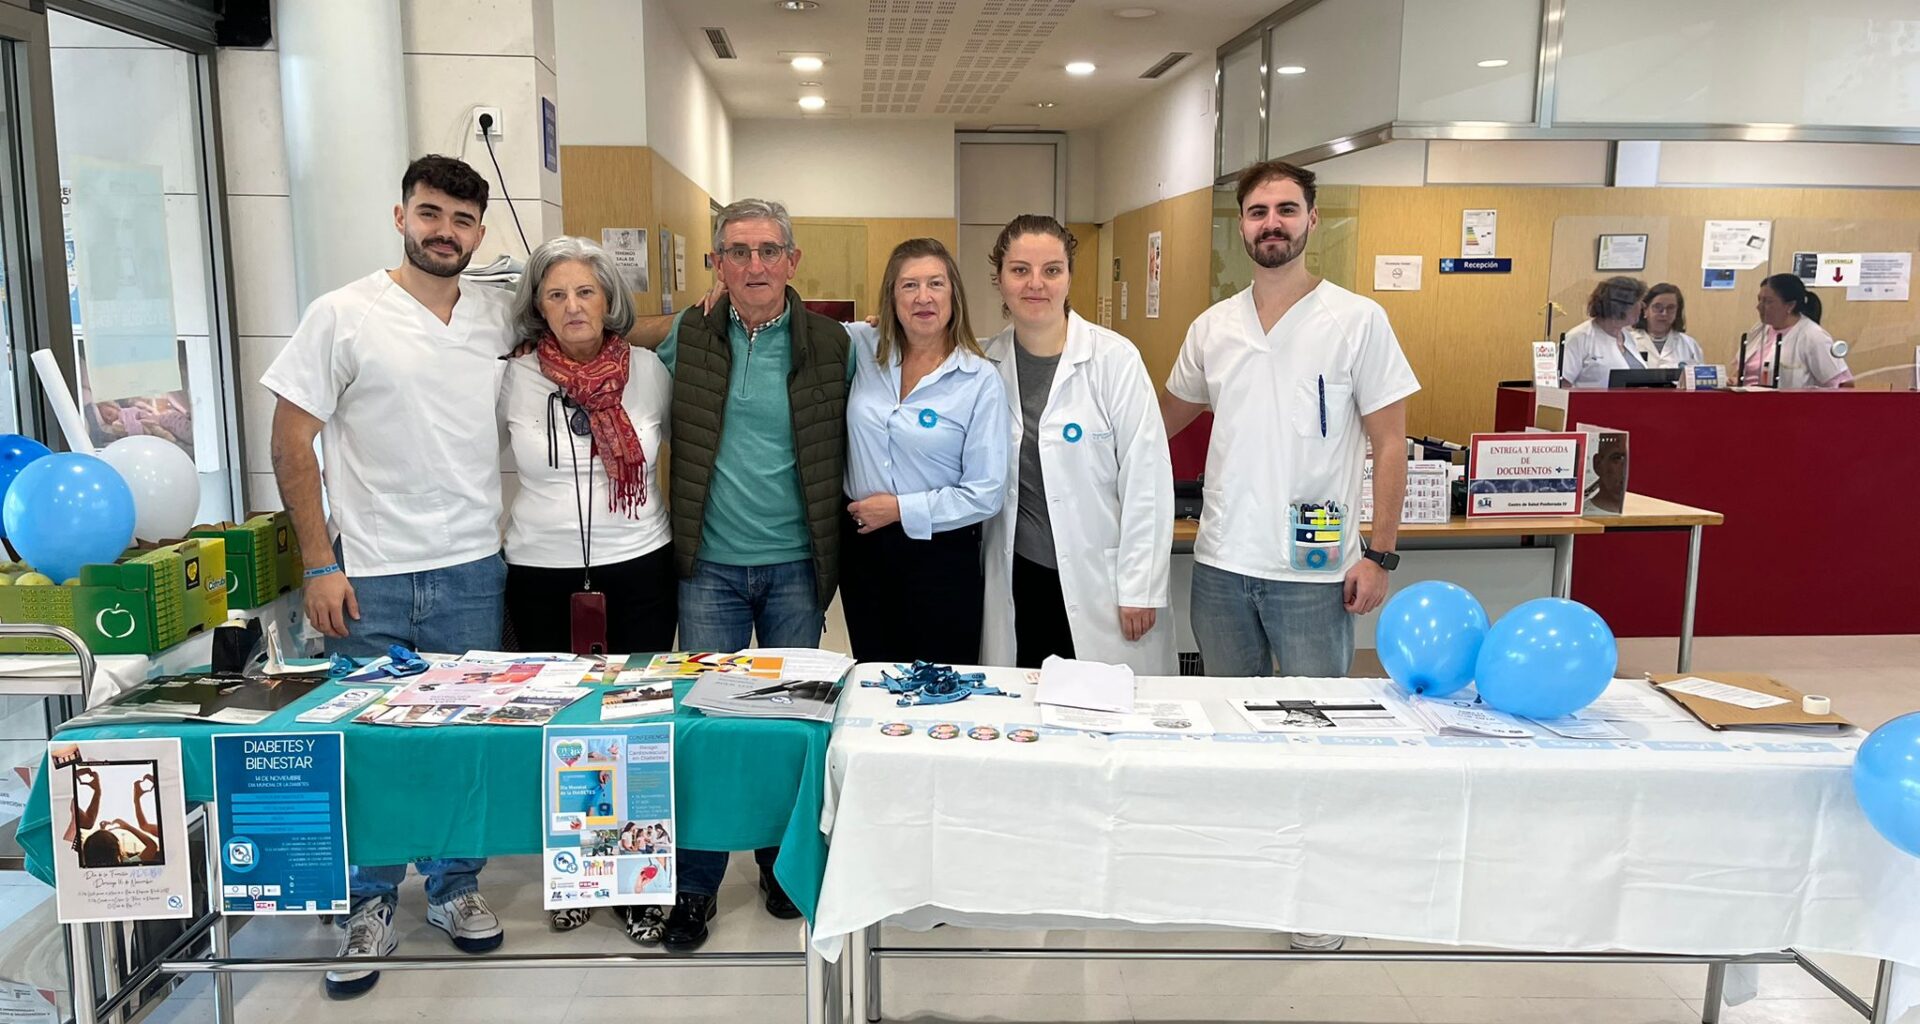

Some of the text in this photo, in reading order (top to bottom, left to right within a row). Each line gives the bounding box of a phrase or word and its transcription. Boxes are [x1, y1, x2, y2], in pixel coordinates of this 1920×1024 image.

[1463, 261, 1499, 270] Recepción
[1490, 446, 1569, 455] ENTREGA Y RECOGIDA
[1520, 457, 1531, 465] DE
[1496, 466, 1553, 476] DOCUMENTOS
[244, 739, 316, 754] DIABETES Y
[245, 756, 313, 770] BIENESTAR
